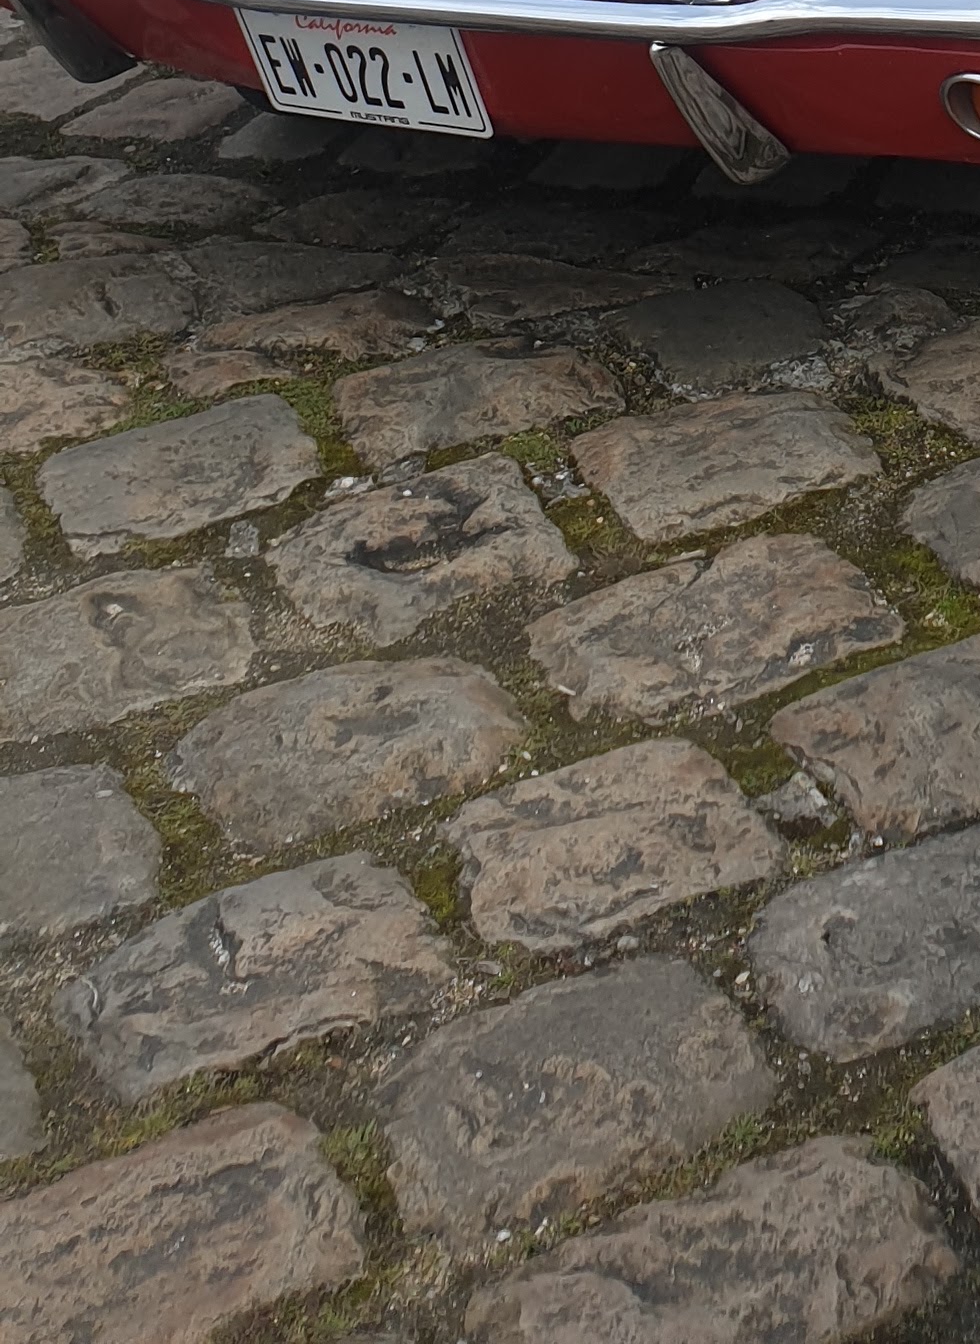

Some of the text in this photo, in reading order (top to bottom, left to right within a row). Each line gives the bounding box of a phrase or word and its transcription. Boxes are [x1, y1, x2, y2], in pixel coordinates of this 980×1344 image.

[295, 14, 398, 41] California
[258, 34, 473, 118] EW-022-LM
[350, 111, 410, 125] MUSTANG
